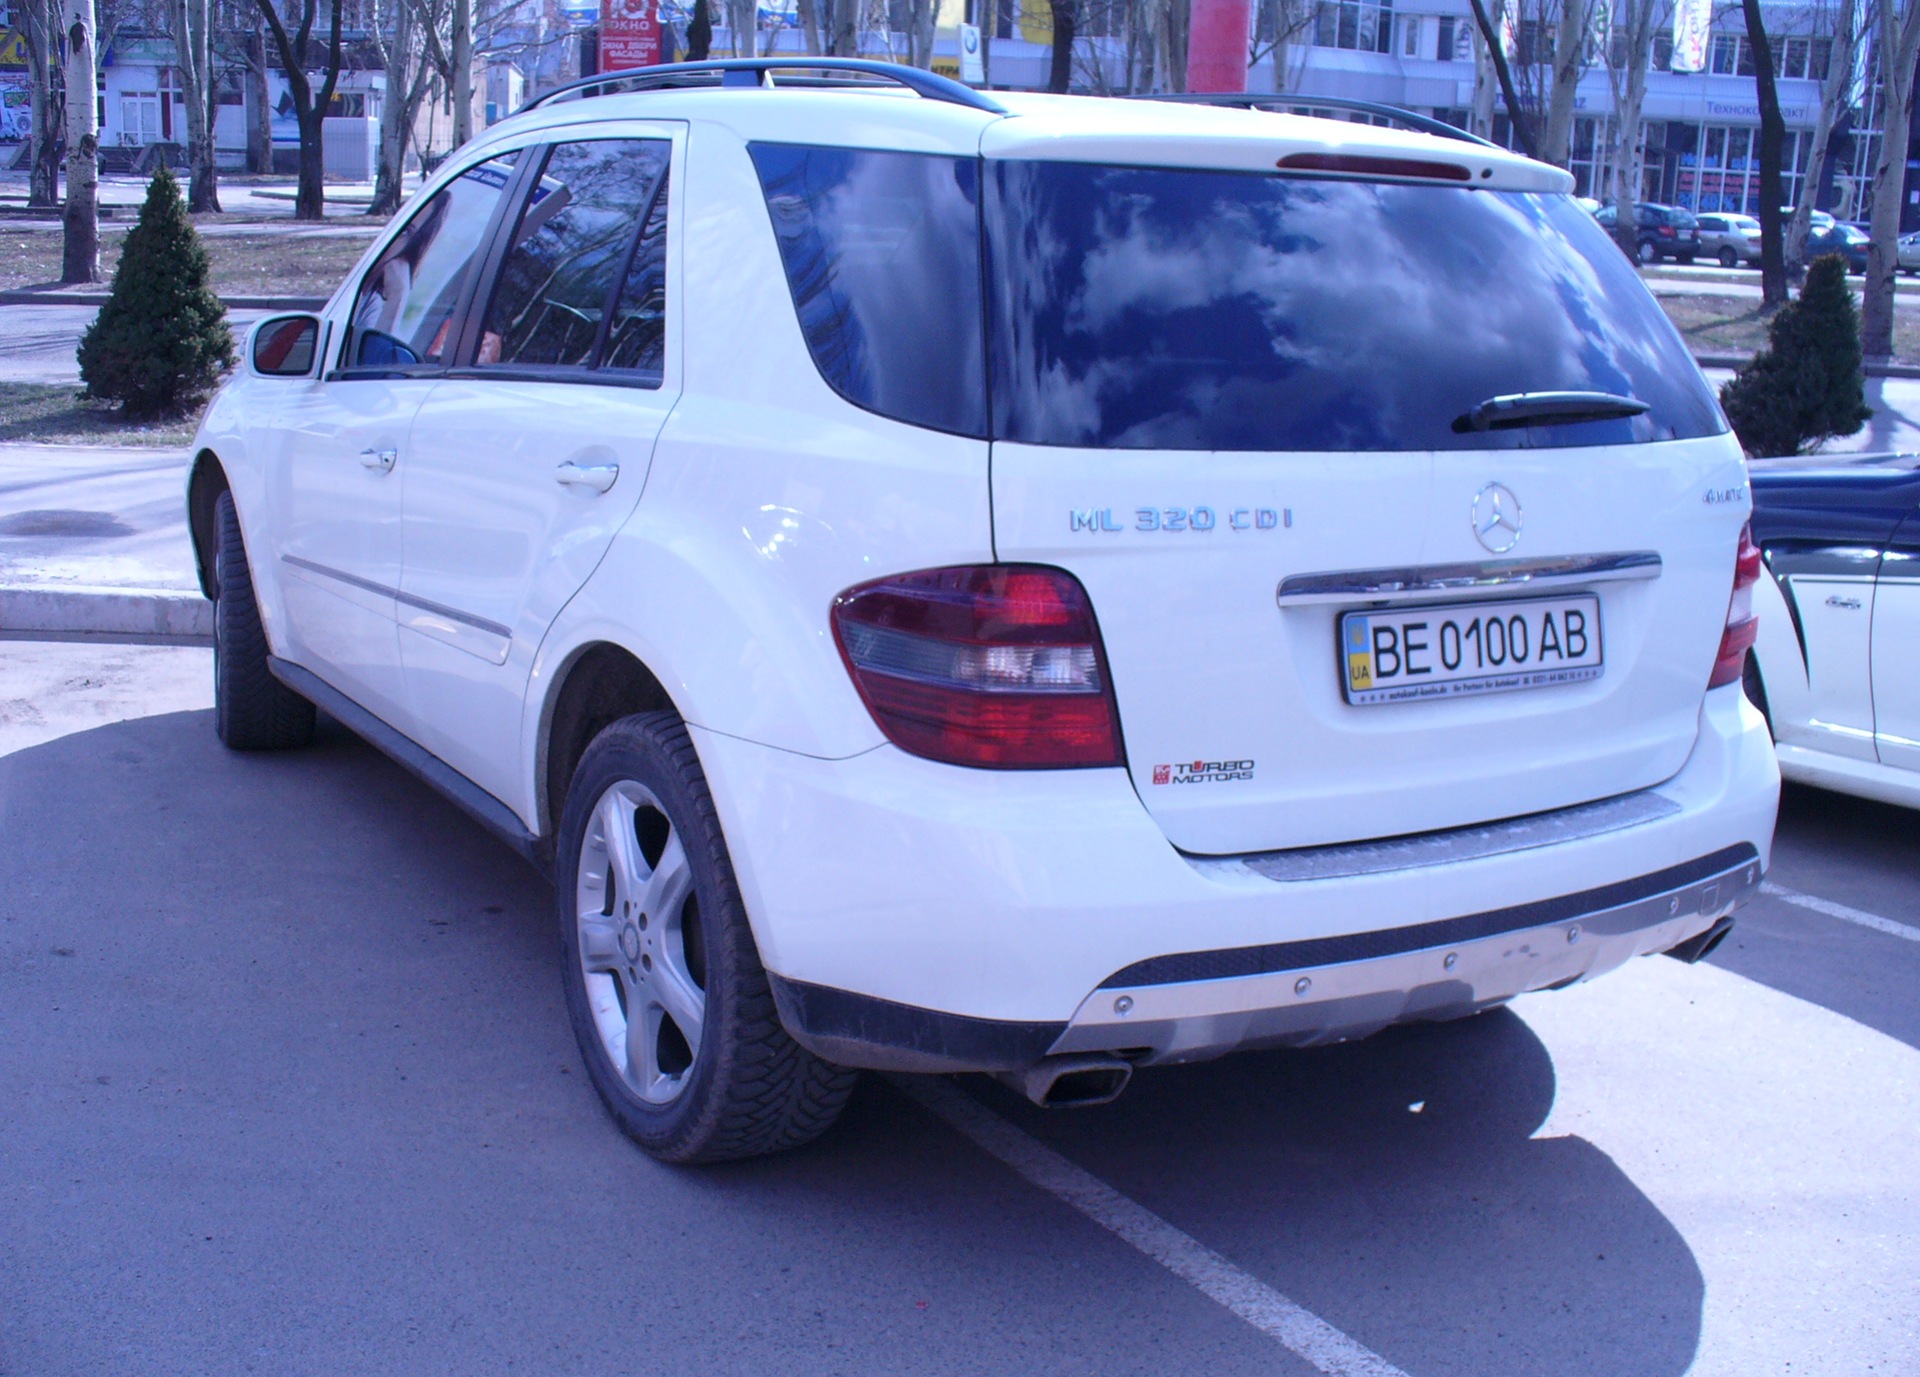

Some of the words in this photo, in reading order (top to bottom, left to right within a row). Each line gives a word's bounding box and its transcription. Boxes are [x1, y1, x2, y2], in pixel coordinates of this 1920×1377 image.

[1706, 101, 1806, 118] Технокоакт
[1070, 507, 1124, 532] ML
[1135, 506, 1216, 531] 320
[1230, 507, 1293, 530] CDI
[1372, 622, 1432, 679] BE
[1440, 614, 1529, 671] 0100
[1538, 609, 1588, 662] AB
[1352, 665, 1370, 680] UA
[1174, 760, 1255, 774] TURBO
[1172, 771, 1254, 784] MOTORS
